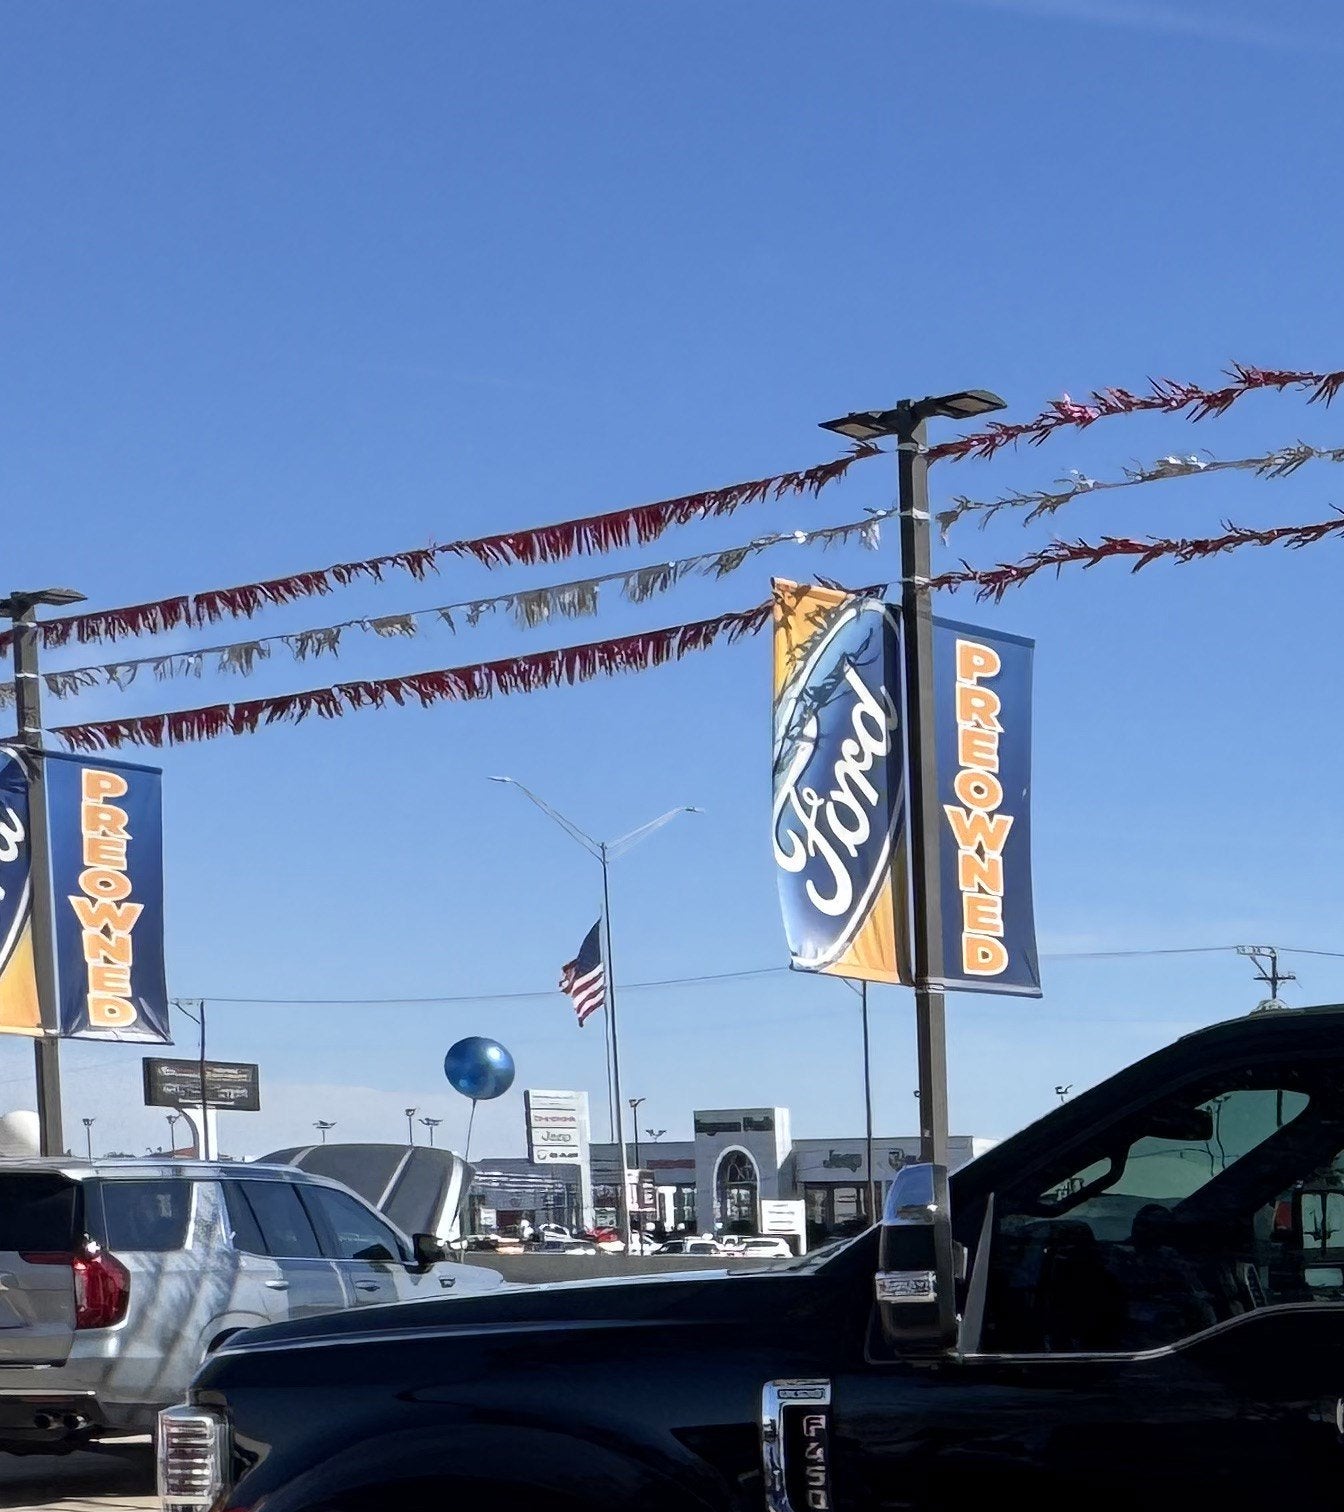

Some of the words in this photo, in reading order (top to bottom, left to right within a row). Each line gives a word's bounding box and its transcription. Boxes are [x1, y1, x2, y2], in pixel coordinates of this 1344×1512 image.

[67, 768, 145, 1027] PREOWNED
[773, 664, 898, 917] Ford
[943, 639, 1014, 976] PREOWNED
